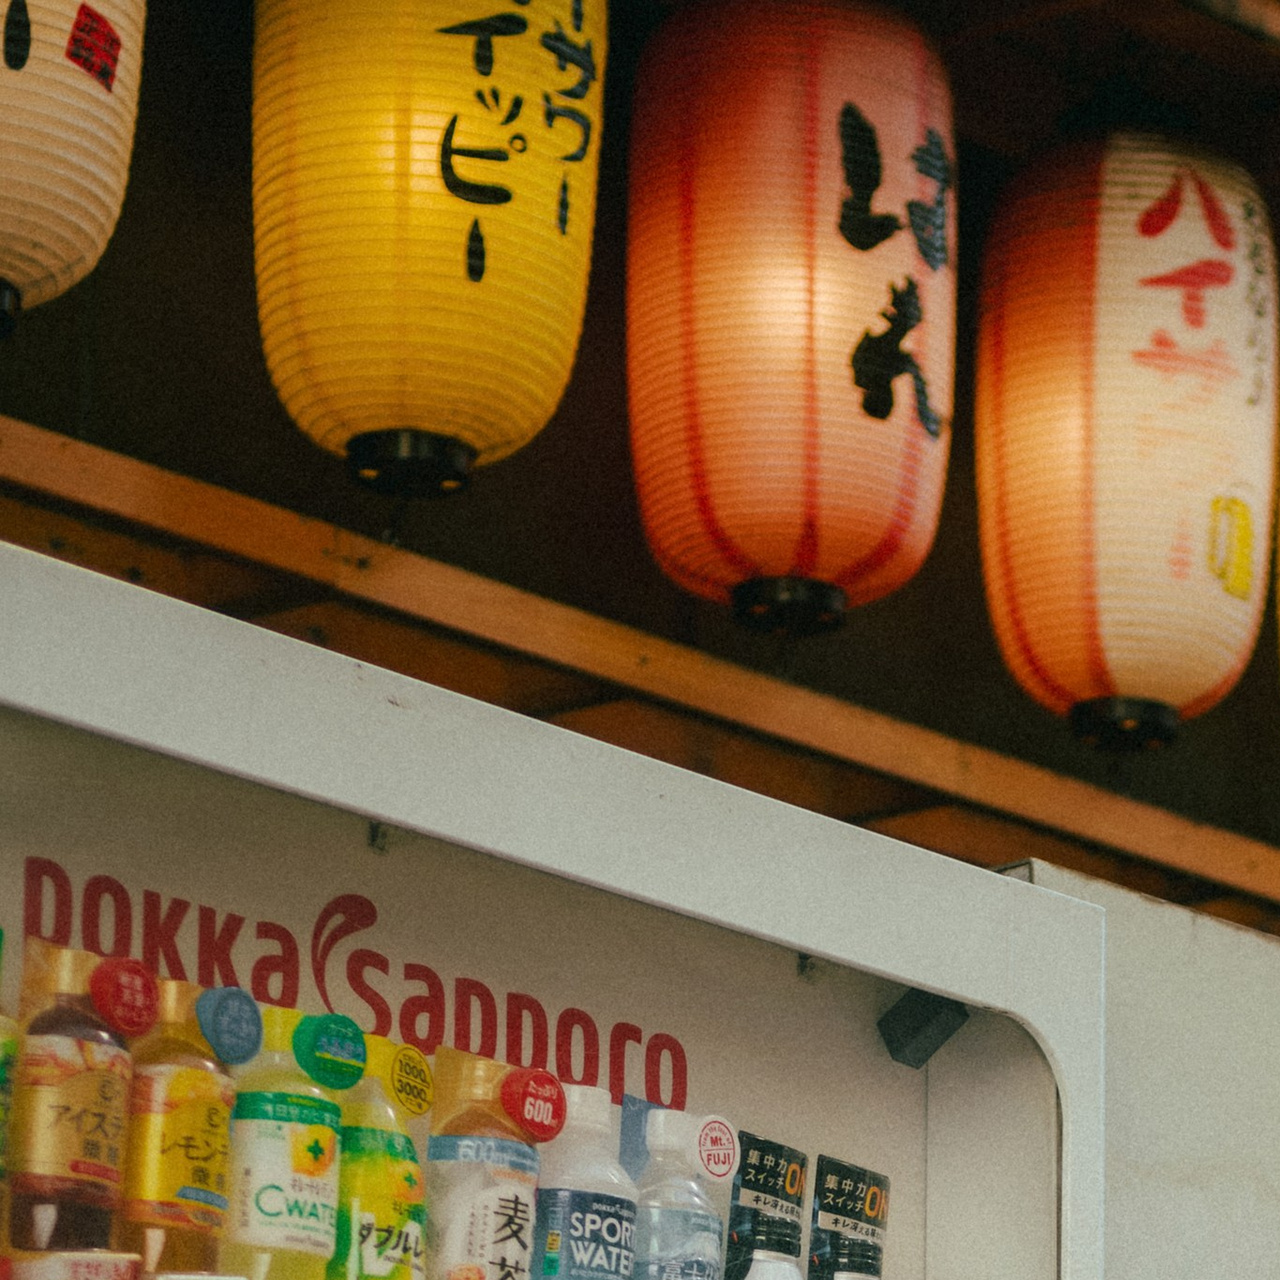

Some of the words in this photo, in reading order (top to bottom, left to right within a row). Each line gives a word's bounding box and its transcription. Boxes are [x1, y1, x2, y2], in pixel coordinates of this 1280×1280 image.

[710, 1136, 726, 1148] Mt.
[706, 1153, 731, 1167] FUJI
[745, 1168, 785, 1190] スイッチ
[824, 1191, 865, 1212] スイッチ
